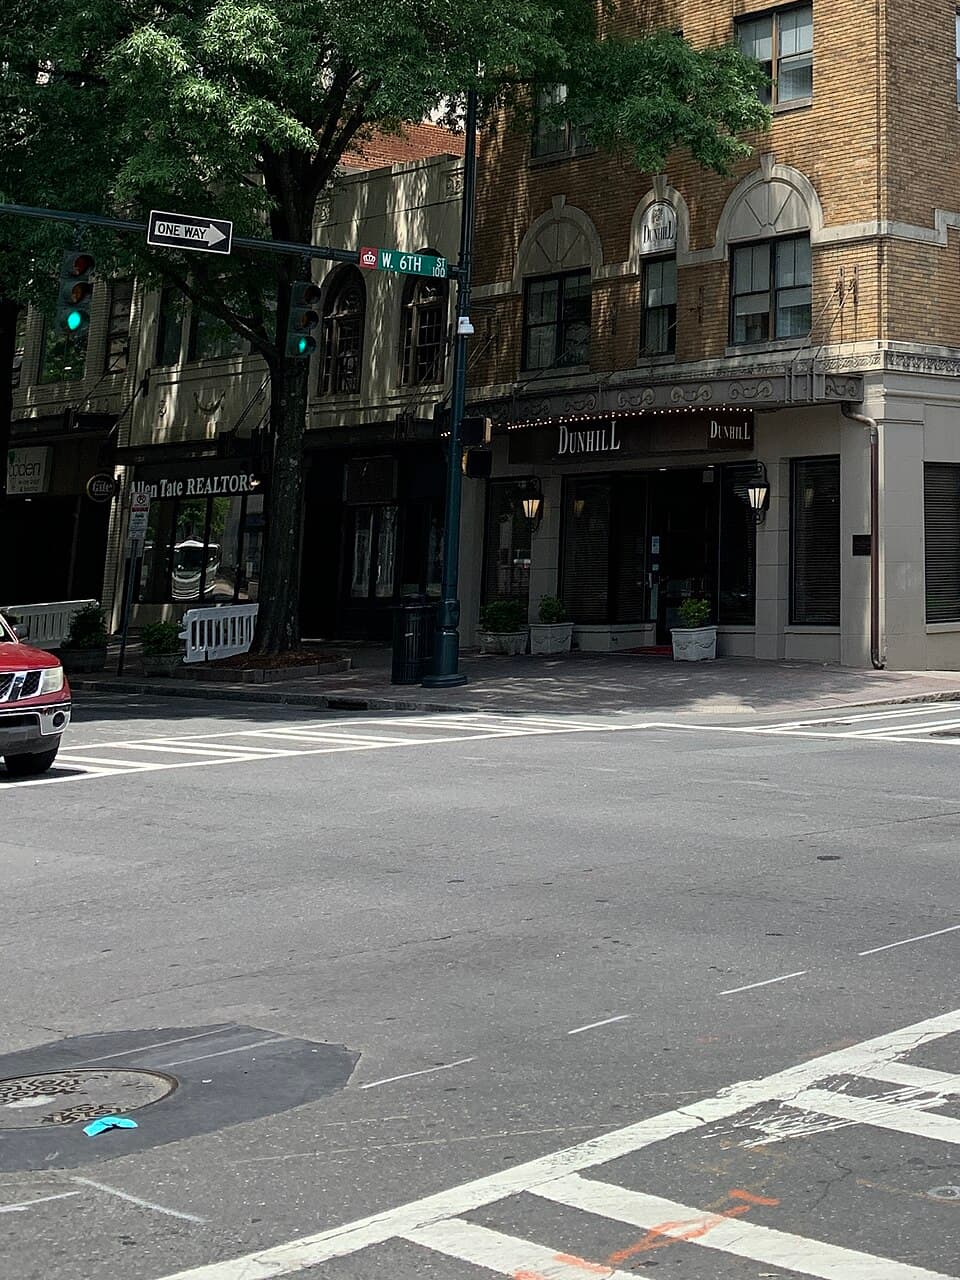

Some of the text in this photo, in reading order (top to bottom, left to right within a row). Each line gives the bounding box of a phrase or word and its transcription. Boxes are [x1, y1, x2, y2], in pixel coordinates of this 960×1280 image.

[158, 223, 206, 239] ONE WAY
[382, 252, 422, 272] W. 6TH
[436, 258, 446, 268] ST
[432, 267, 446, 278] 100
[558, 420, 621, 455] DUNHILL
[710, 420, 751, 440] DUNHILL
[129, 480, 158, 499] Allen
[160, 479, 183, 497] Tate
[185, 473, 256, 495] REALTORS
